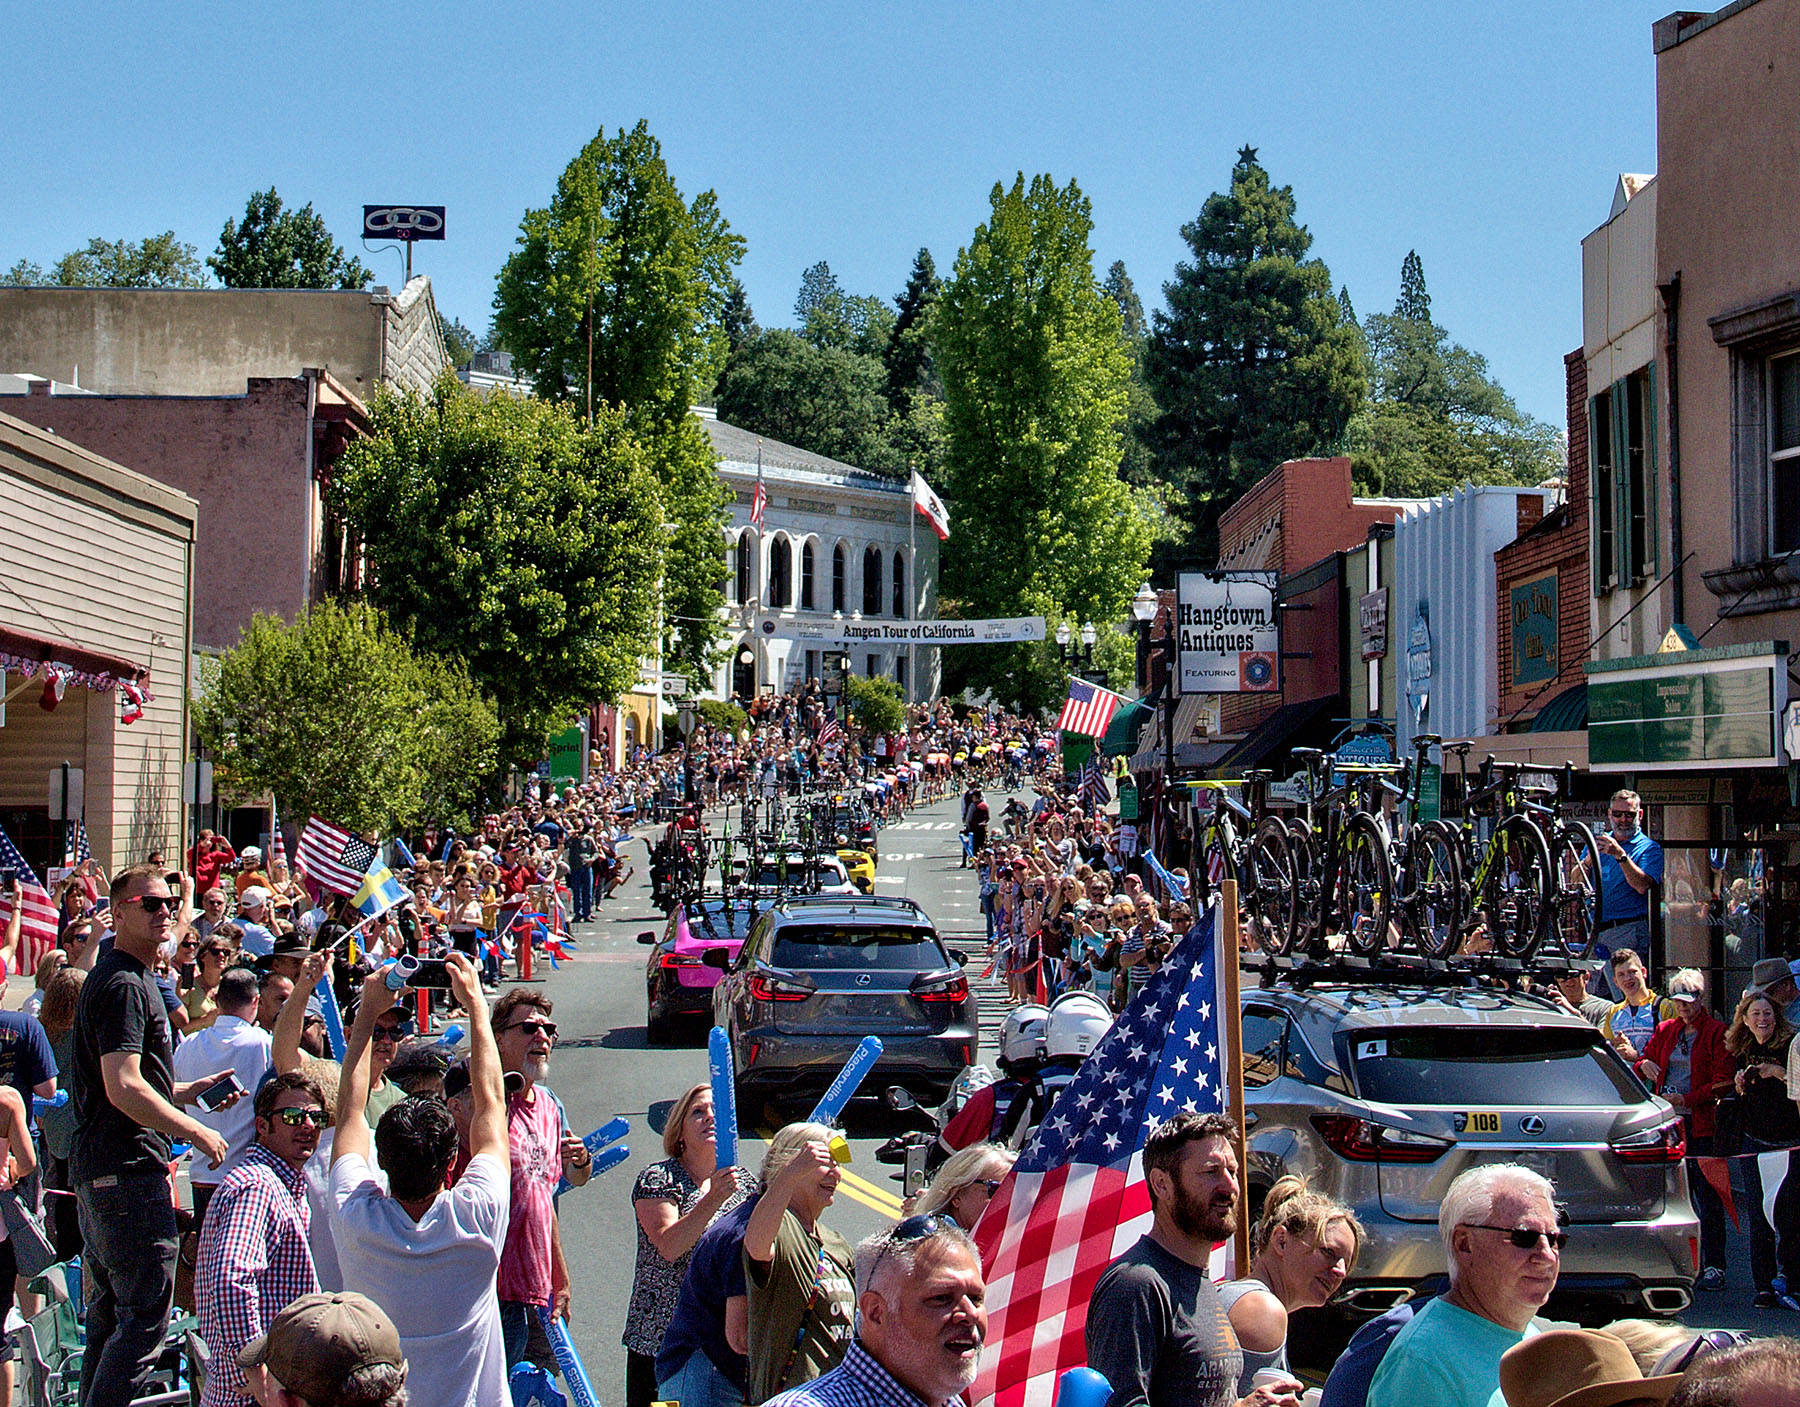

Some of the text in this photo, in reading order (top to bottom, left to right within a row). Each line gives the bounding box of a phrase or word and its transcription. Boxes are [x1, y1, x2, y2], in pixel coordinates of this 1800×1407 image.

[1180, 604, 1266, 630] Hangtown
[843, 624, 976, 641] Amgen Tour of California
[1181, 630, 1254, 656] Antiques
[551, 742, 580, 753] Sprint
[1338, 755, 1387, 764] NTIQUES
[1366, 1043, 1378, 1054] 4
[827, 1047, 869, 1102] Placerville
[1472, 1114, 1498, 1131] 108
[830, 1325, 854, 1340] WA
